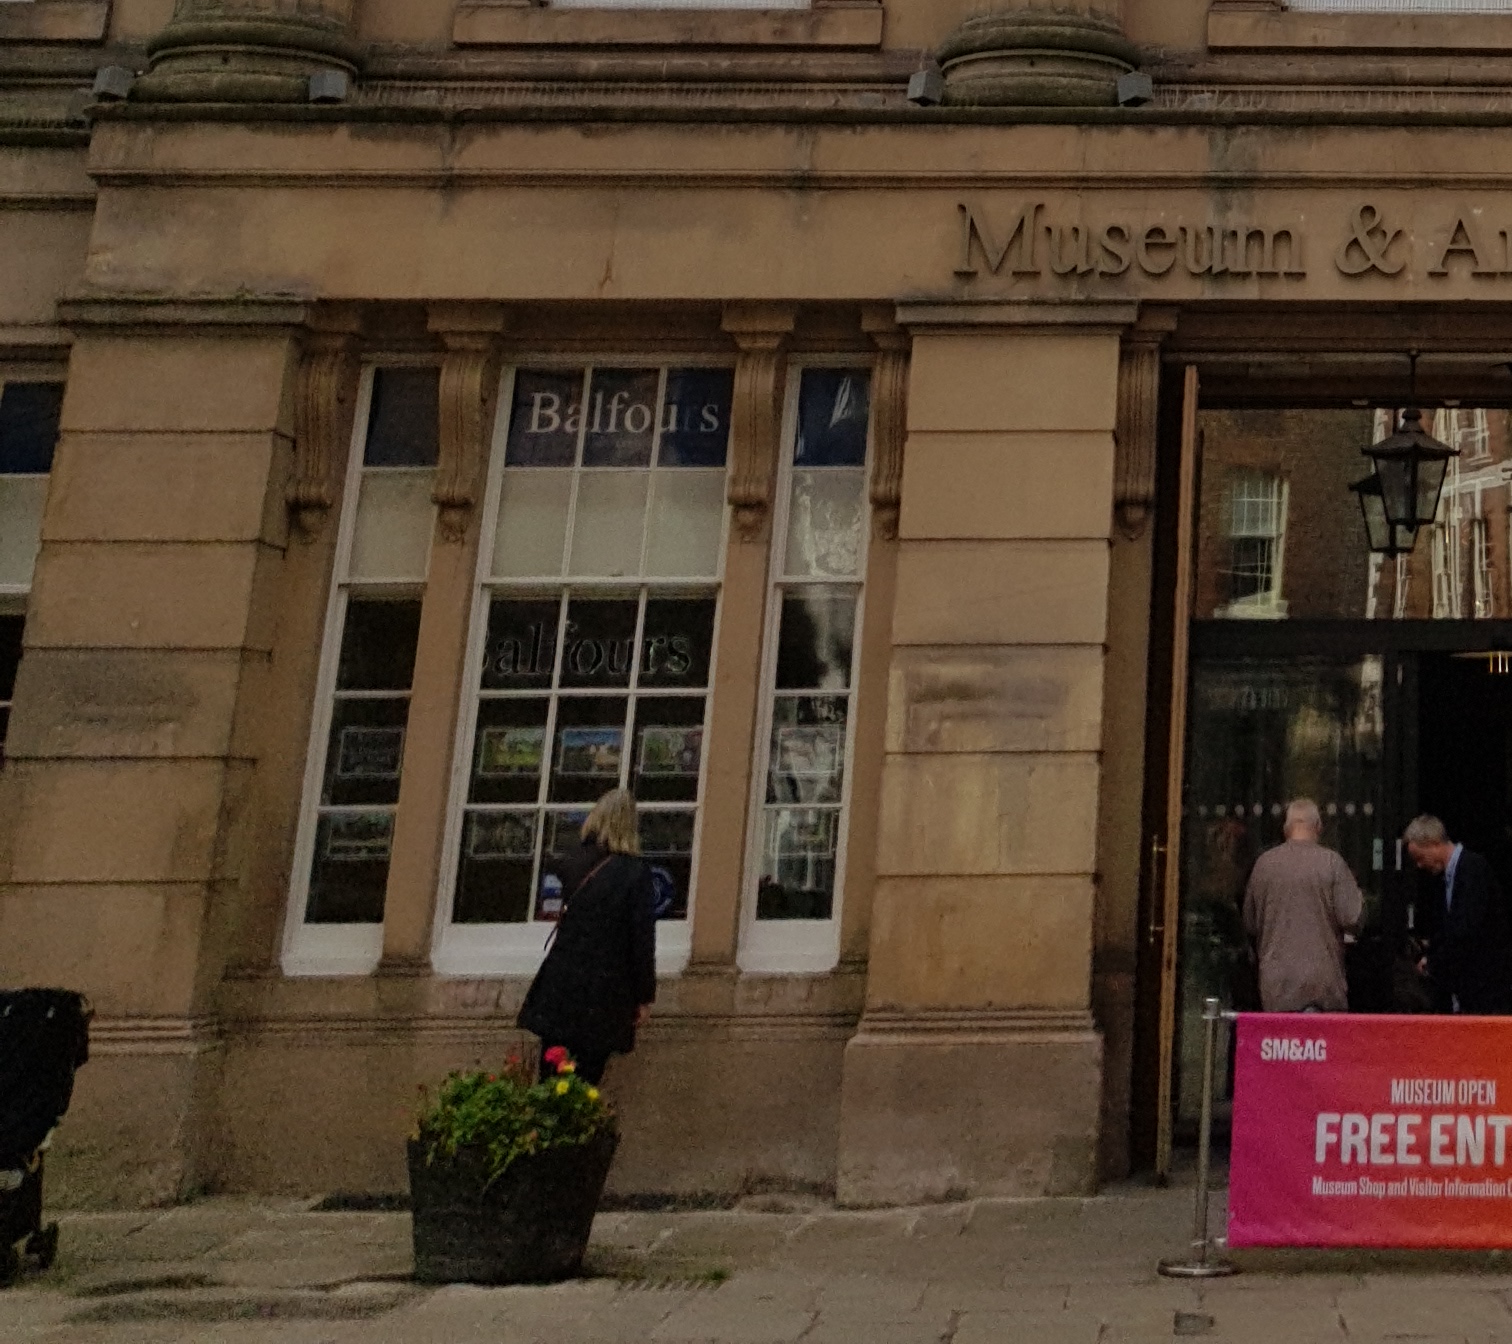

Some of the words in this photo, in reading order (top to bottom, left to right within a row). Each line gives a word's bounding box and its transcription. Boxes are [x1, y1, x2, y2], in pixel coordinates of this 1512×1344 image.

[954, 203, 1307, 279] Museum
[1335, 204, 1409, 278] &
[483, 620, 692, 676] alours
[1260, 1038, 1327, 1061] SM&AG
[1391, 1078, 1455, 1105] MUSEUM
[1458, 1079, 1497, 1105] OPEN
[1314, 1112, 1423, 1165] FREE
[1312, 1176, 1358, 1196] Museum
[1359, 1177, 1386, 1199] Shop
[1387, 1177, 1408, 1196] and
[1409, 1177, 1443, 1197] Visitor
[1444, 1178, 1506, 1198] Information
